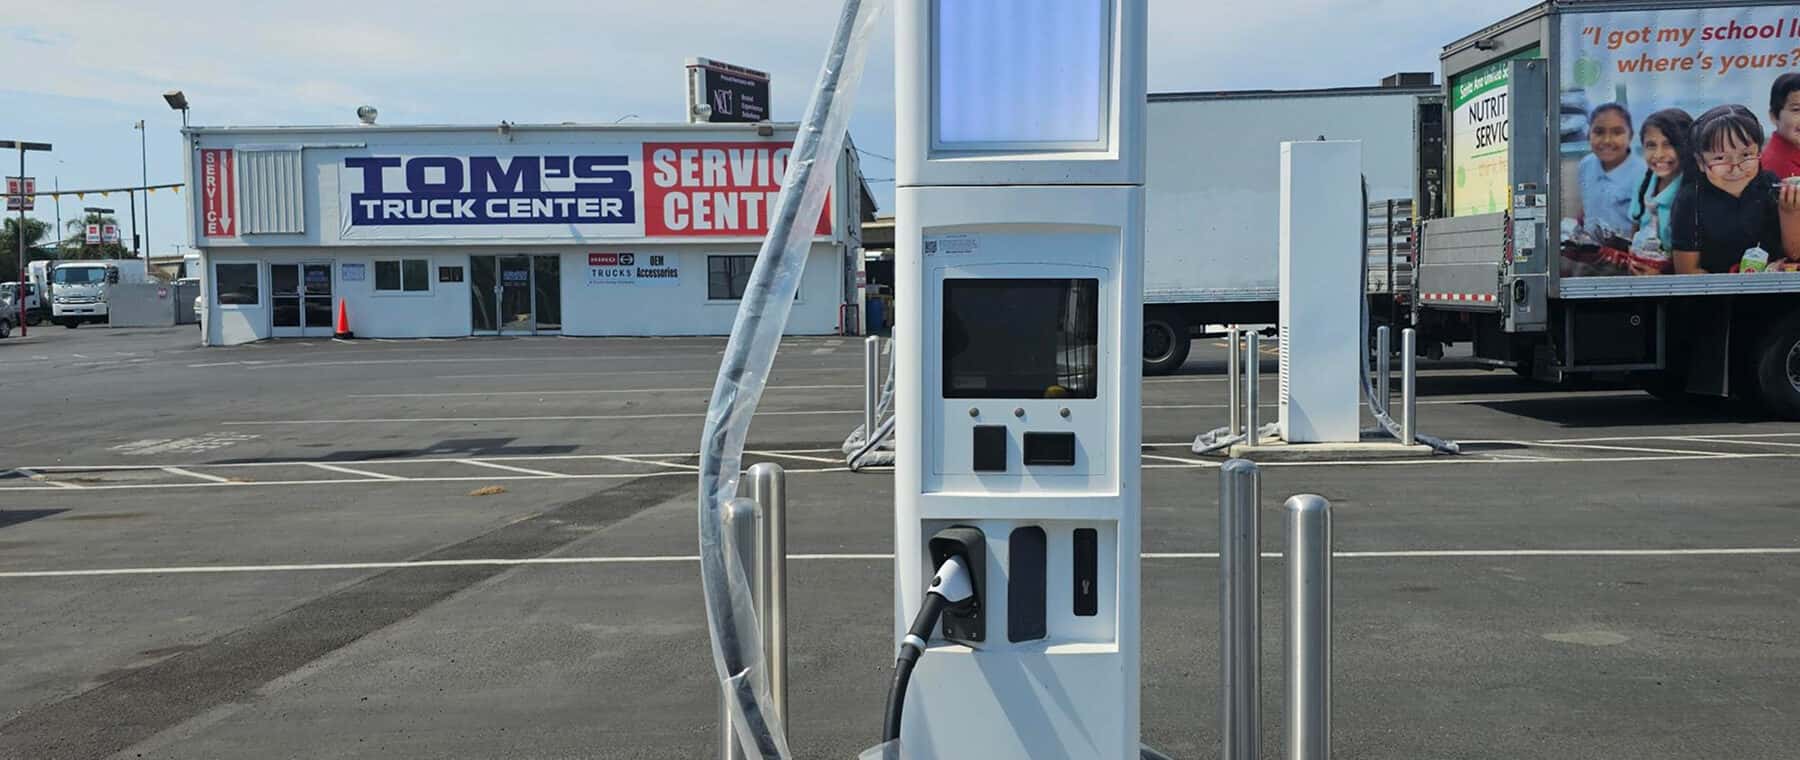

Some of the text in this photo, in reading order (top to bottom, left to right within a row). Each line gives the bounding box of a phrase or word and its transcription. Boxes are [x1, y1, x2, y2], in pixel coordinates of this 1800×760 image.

[1607, 26, 1650, 49] got
[1656, 27, 1695, 47] my
[1701, 18, 1784, 40] school
[1617, 48, 1800, 75] where's yours?
[1468, 92, 1508, 126] NUTRIT
[1475, 119, 1509, 149] SERVIC
[345, 156, 633, 194] TOM'S
[652, 147, 794, 188] SERVIC
[206, 151, 218, 235] SERVICE
[360, 197, 624, 219] TRUCK CENTER
[591, 268, 633, 277] TRUCKS
[636, 266, 678, 278] Accessories
